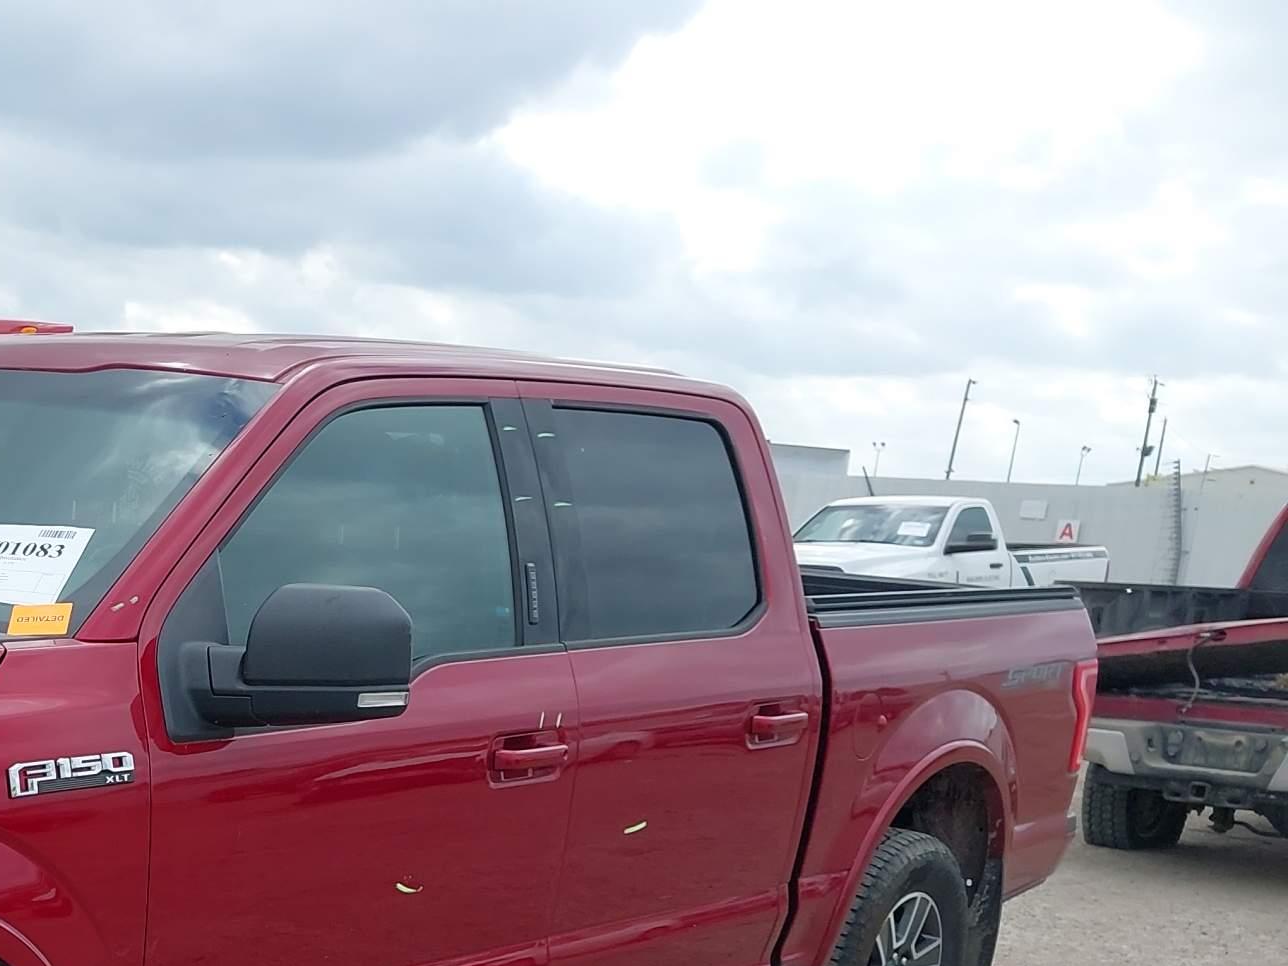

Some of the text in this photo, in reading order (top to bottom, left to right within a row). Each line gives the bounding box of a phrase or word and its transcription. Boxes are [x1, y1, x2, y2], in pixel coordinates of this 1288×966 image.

[1059, 522, 1074, 540] A
[16, 615, 65, 623] DETAILED
[105, 773, 131, 784] XLT
